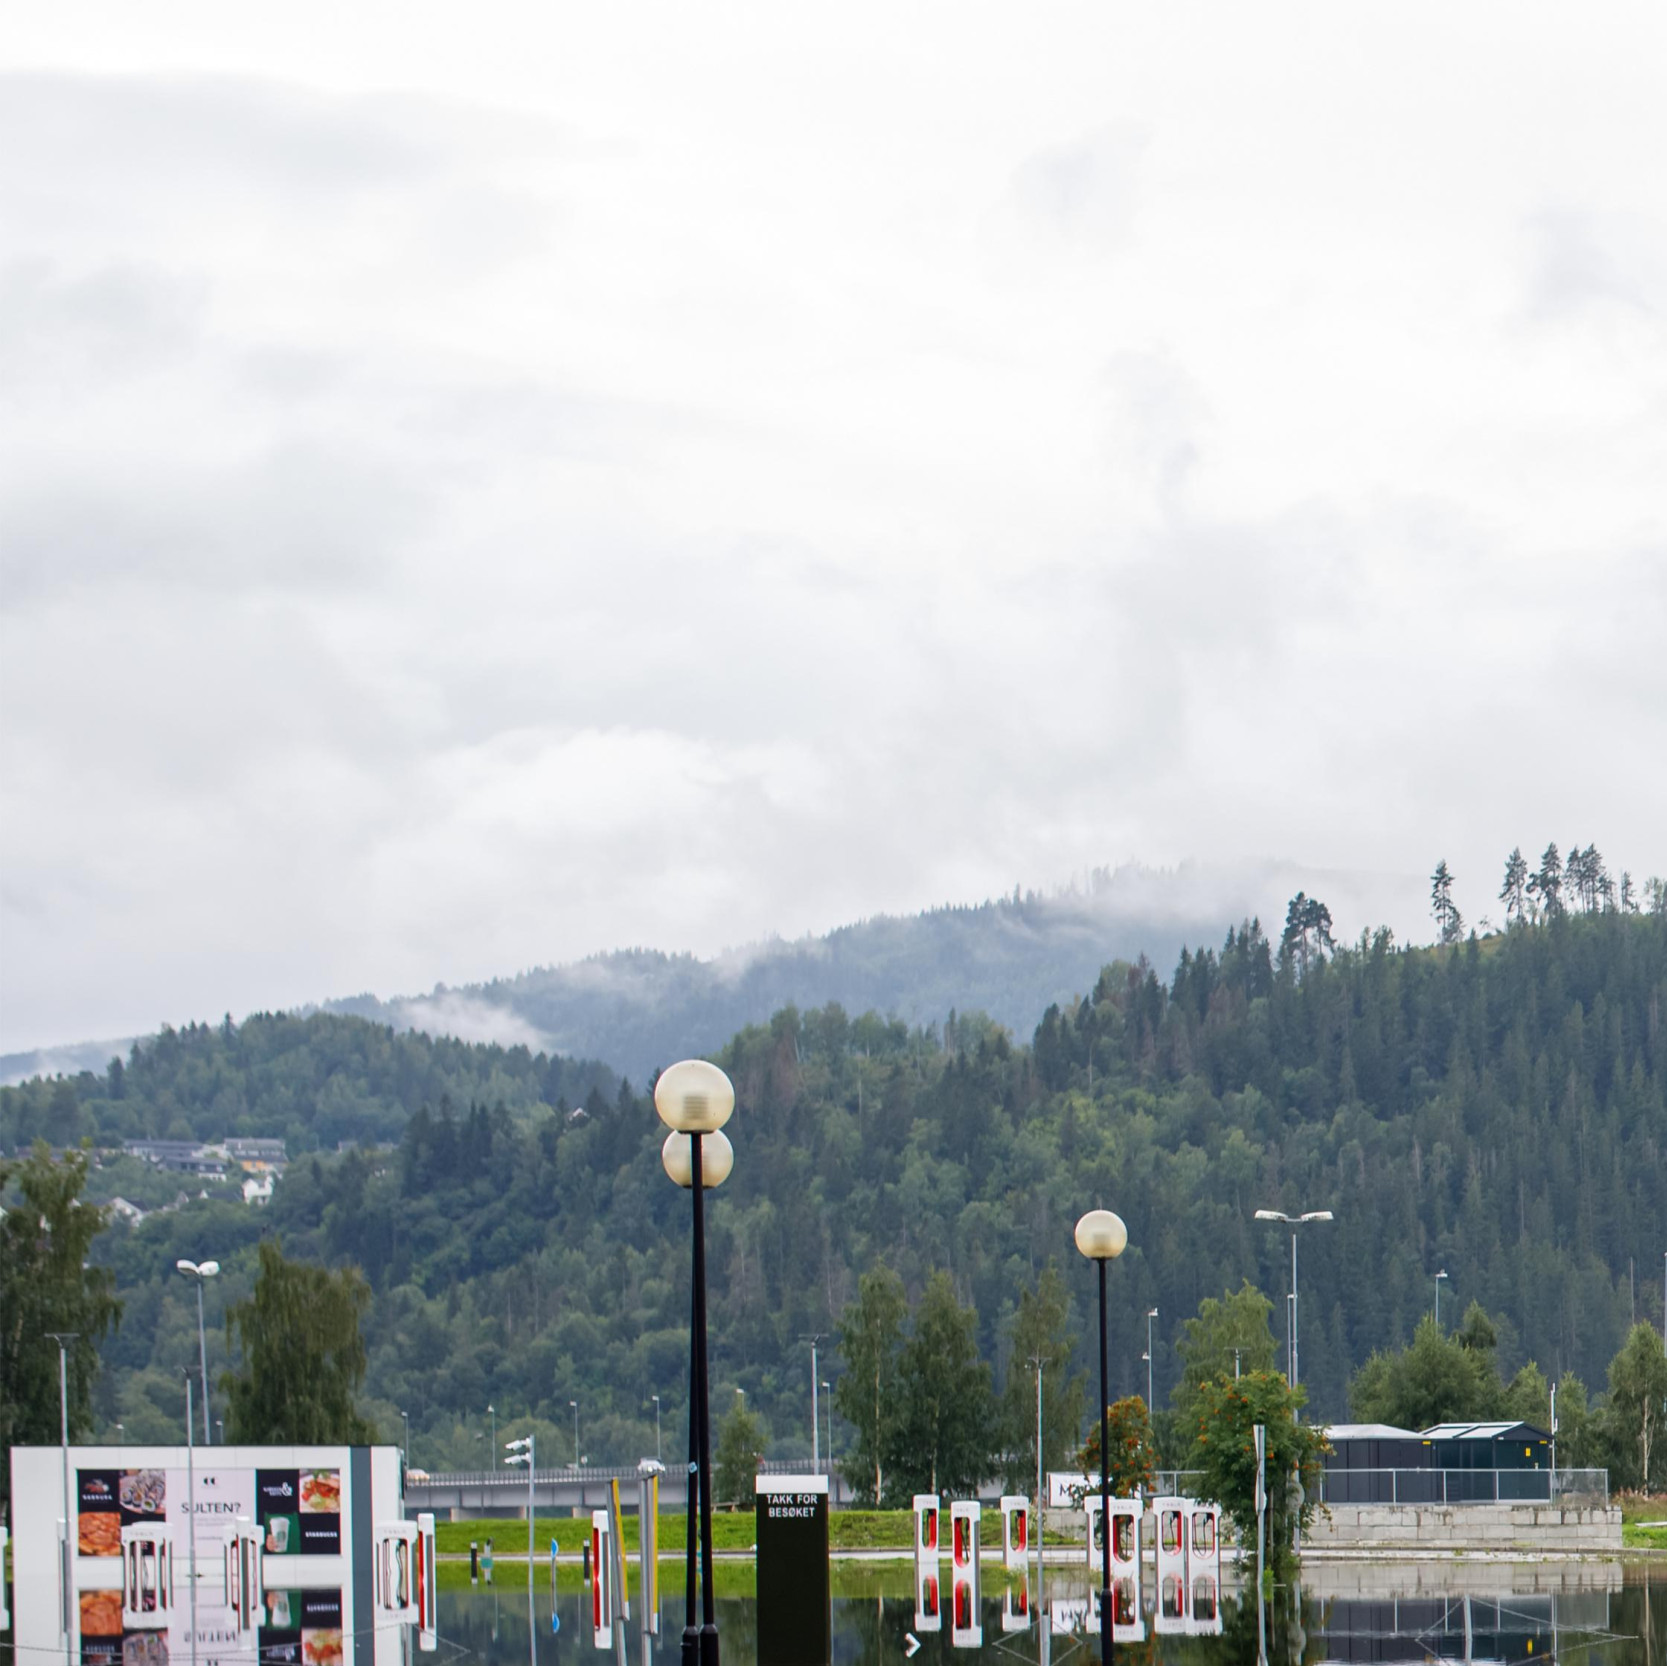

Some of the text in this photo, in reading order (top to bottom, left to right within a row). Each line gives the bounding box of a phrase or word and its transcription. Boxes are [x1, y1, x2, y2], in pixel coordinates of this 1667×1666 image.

[766, 1494, 818, 1505] TAKK FOR
[768, 1506, 816, 1518] BESØKET
